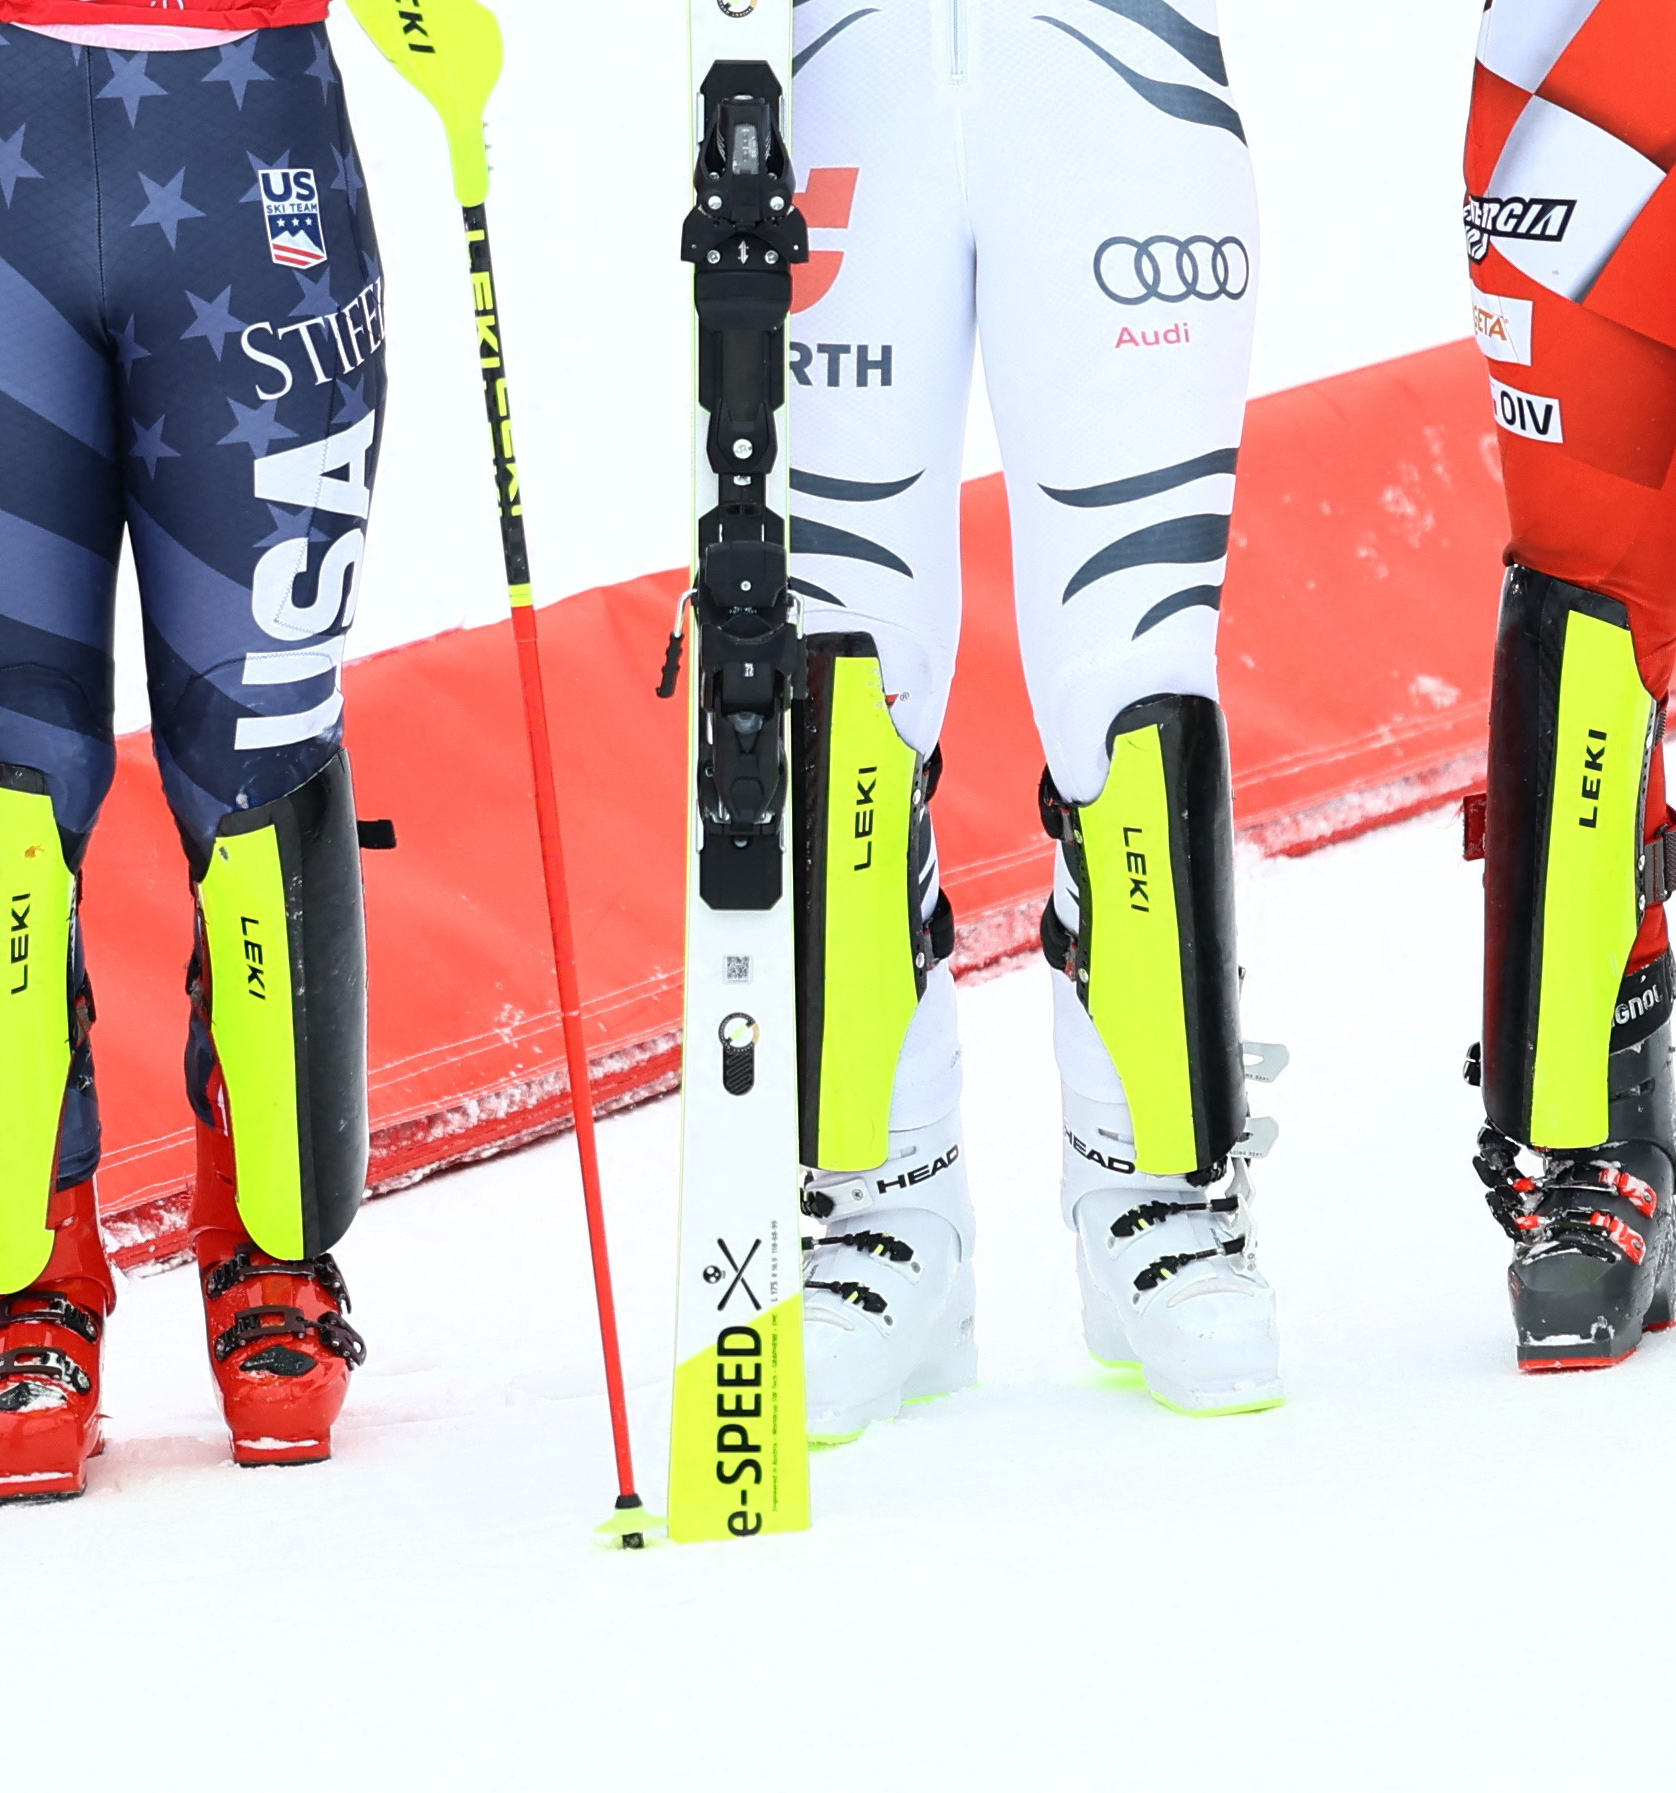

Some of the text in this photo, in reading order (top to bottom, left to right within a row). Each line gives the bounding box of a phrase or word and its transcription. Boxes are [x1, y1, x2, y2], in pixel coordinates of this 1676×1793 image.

[261, 169, 317, 205] US
[266, 203, 318, 215] SKI TEAM
[240, 277, 386, 401] STIFEL
[463, 229, 502, 370] LEKI
[1114, 322, 1192, 349] Audi
[791, 343, 894, 388] RTH
[234, 408, 376, 753] USA
[853, 765, 878, 872] LEKI
[1579, 728, 1608, 829] LEKI
[1122, 826, 1150, 914] LEKI
[10, 891, 31, 997] LEKI
[239, 915, 268, 1001] LEKI
[876, 1143, 960, 1195] HEAD
[1063, 1124, 1137, 1176] HEAD
[716, 1323, 763, 1538] e-SPEED
